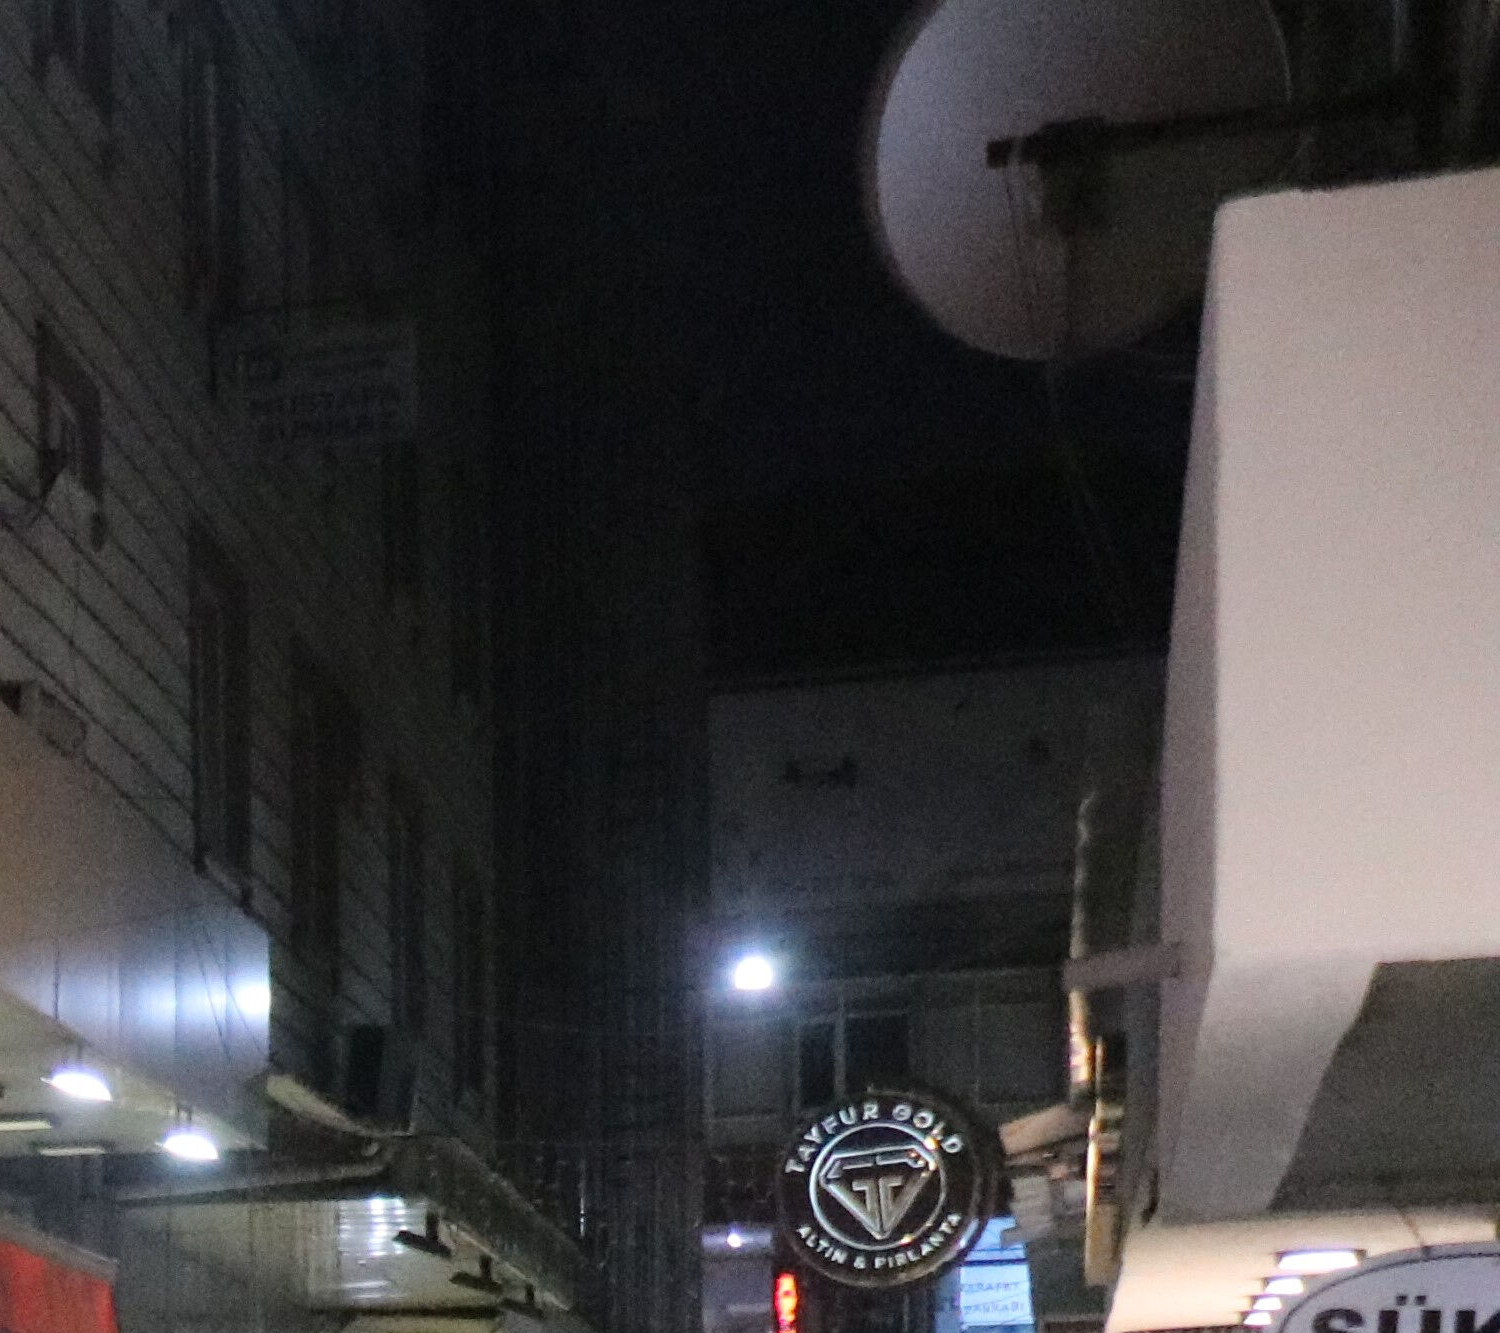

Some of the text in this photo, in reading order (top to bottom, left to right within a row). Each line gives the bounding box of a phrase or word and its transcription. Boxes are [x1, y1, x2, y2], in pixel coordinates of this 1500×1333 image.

[785, 1102, 964, 1174] TAYFUR GOLD
[796, 1223, 849, 1265] ALTIN
[873, 1212, 962, 1270] PIRLANTA
